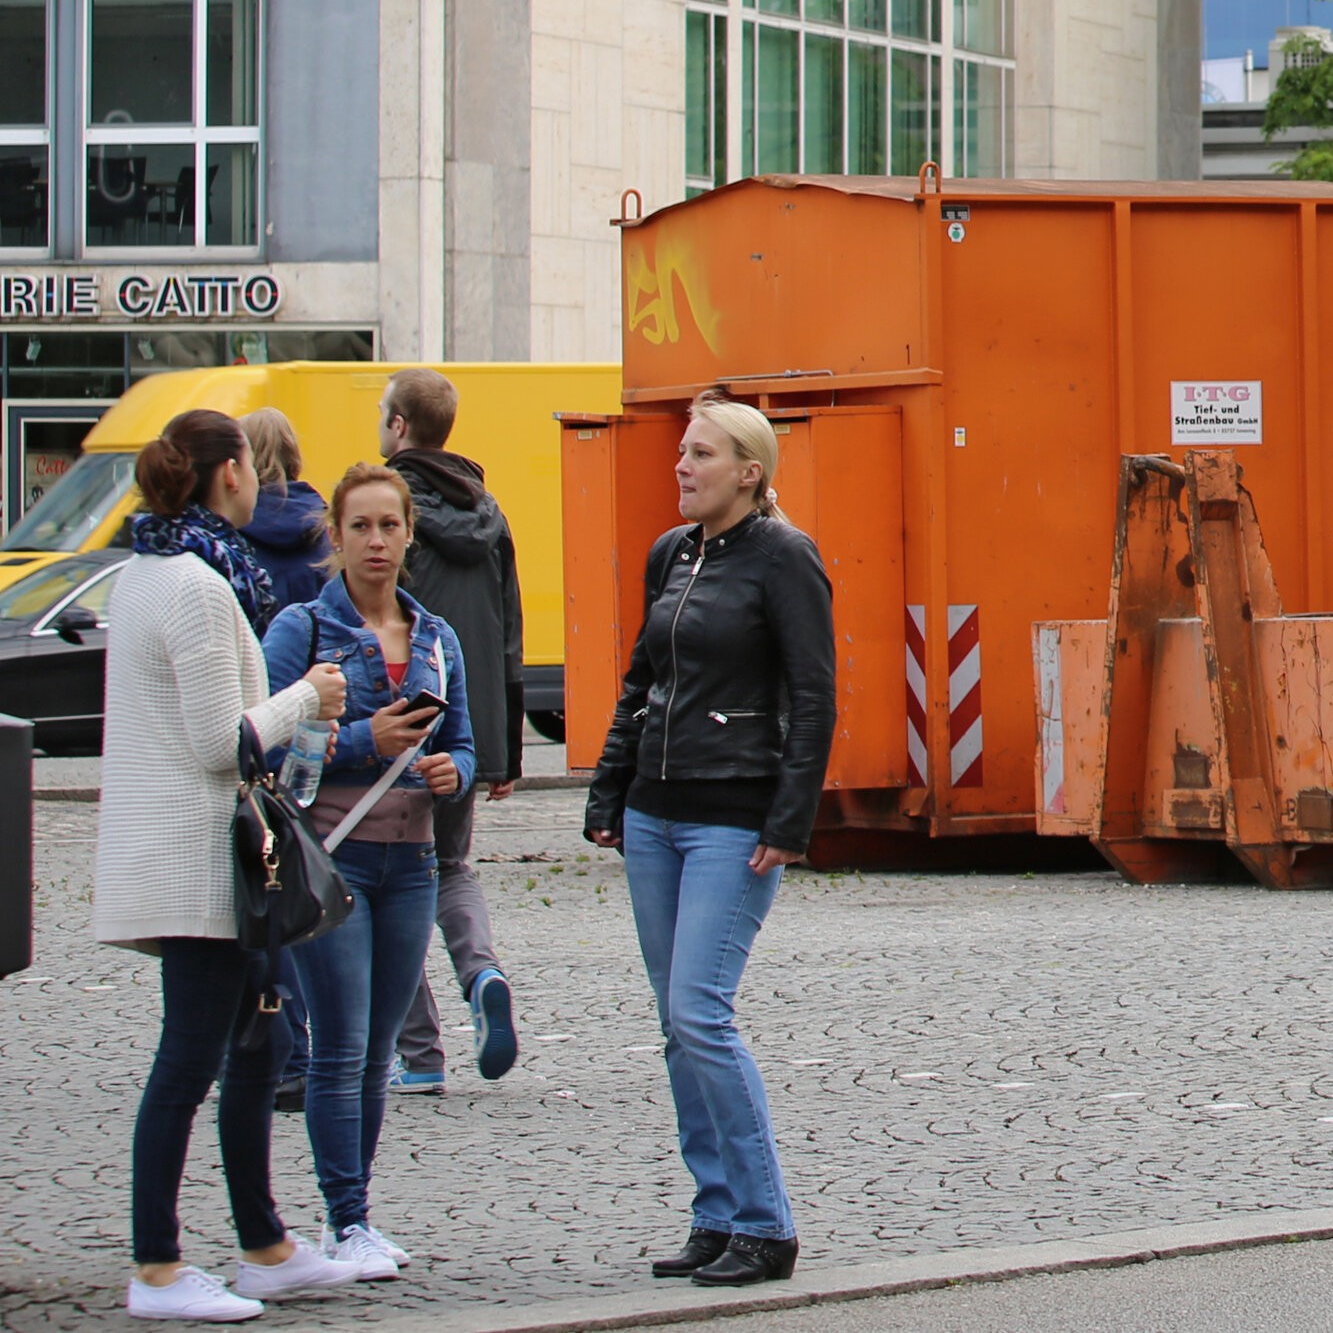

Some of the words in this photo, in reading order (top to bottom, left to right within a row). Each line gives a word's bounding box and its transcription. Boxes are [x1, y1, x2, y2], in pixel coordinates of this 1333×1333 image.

[116, 274, 282, 317] CATTO
[1194, 405, 1217, 414] Tief-
[1221, 405, 1239, 414] und
[1175, 416, 1234, 425] Straßenbau
